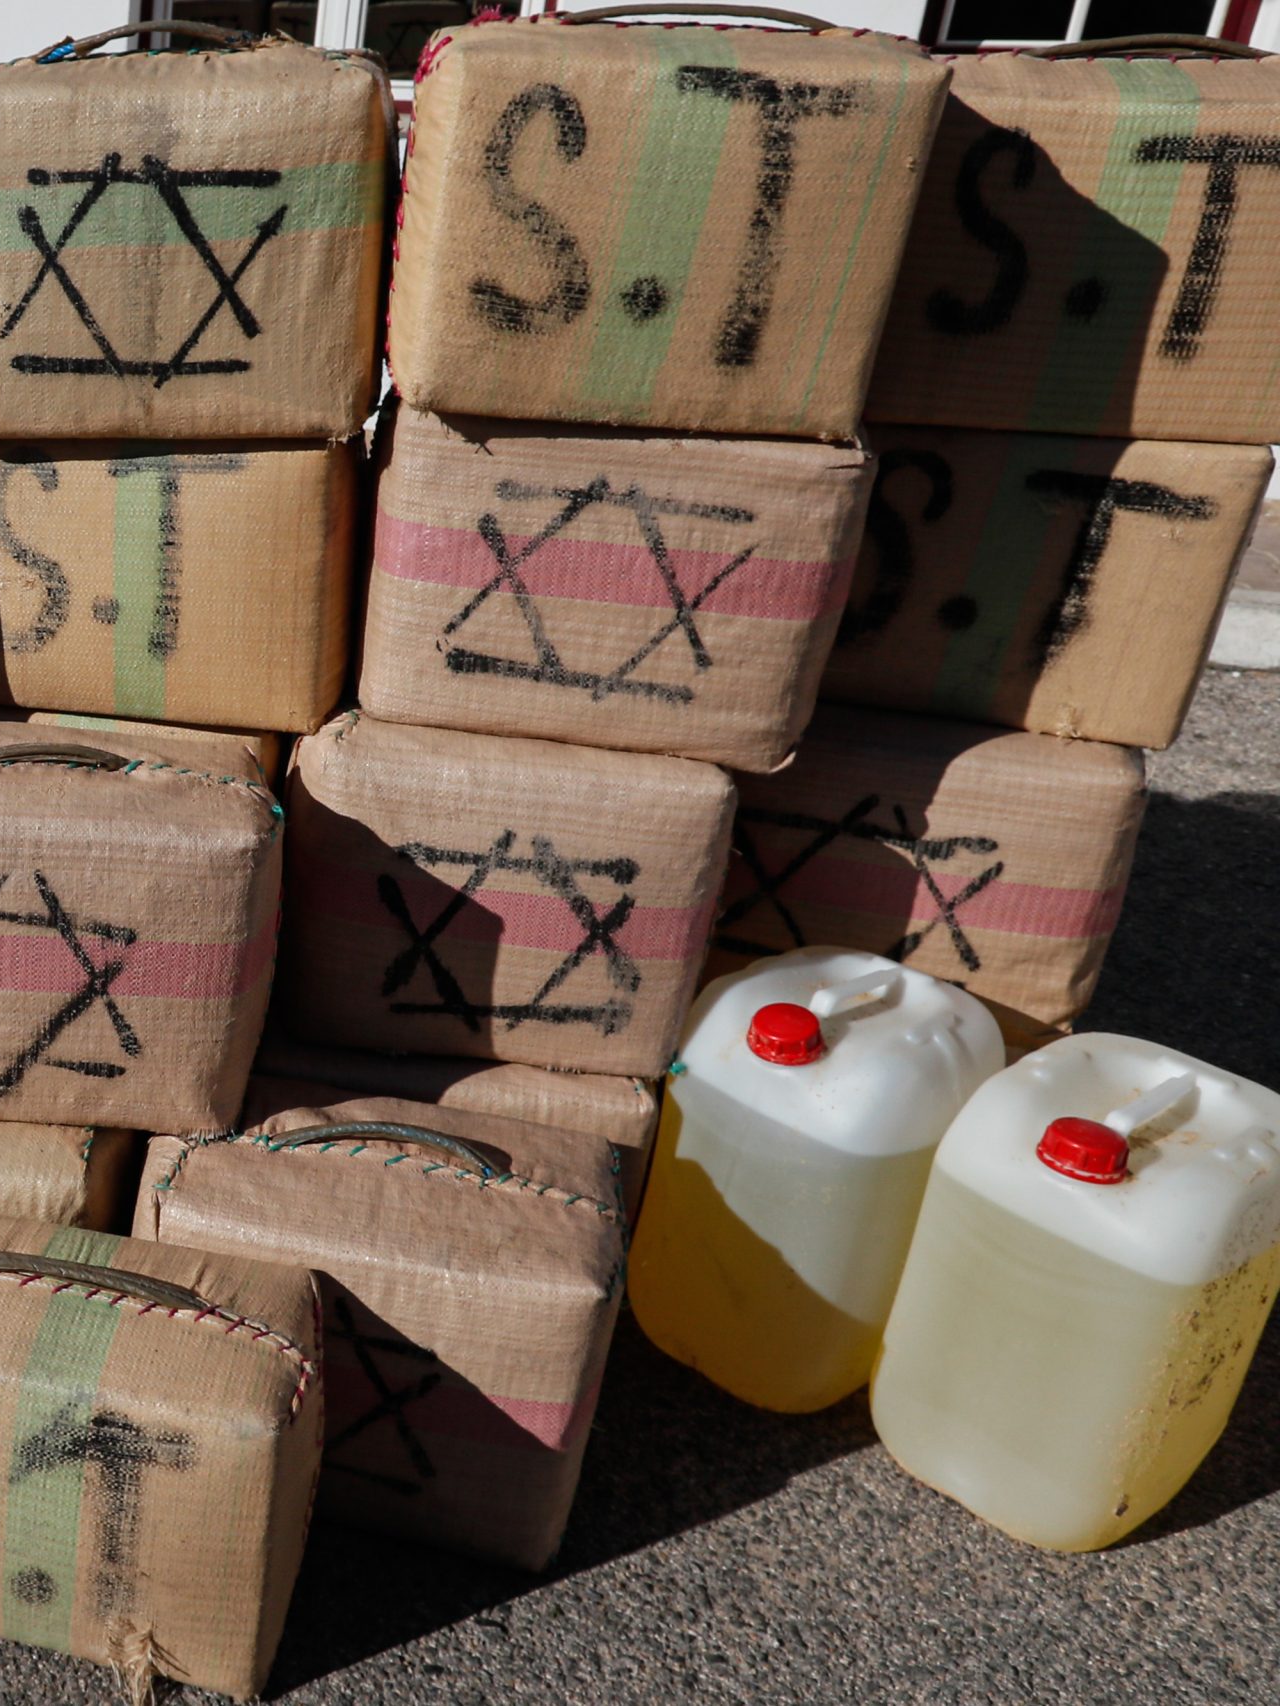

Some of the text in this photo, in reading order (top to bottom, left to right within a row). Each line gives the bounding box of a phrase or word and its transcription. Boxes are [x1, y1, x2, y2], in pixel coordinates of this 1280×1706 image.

[469, 65, 863, 367] S.T
[926, 127, 1280, 364] S.T
[835, 449, 1218, 672] S.T
